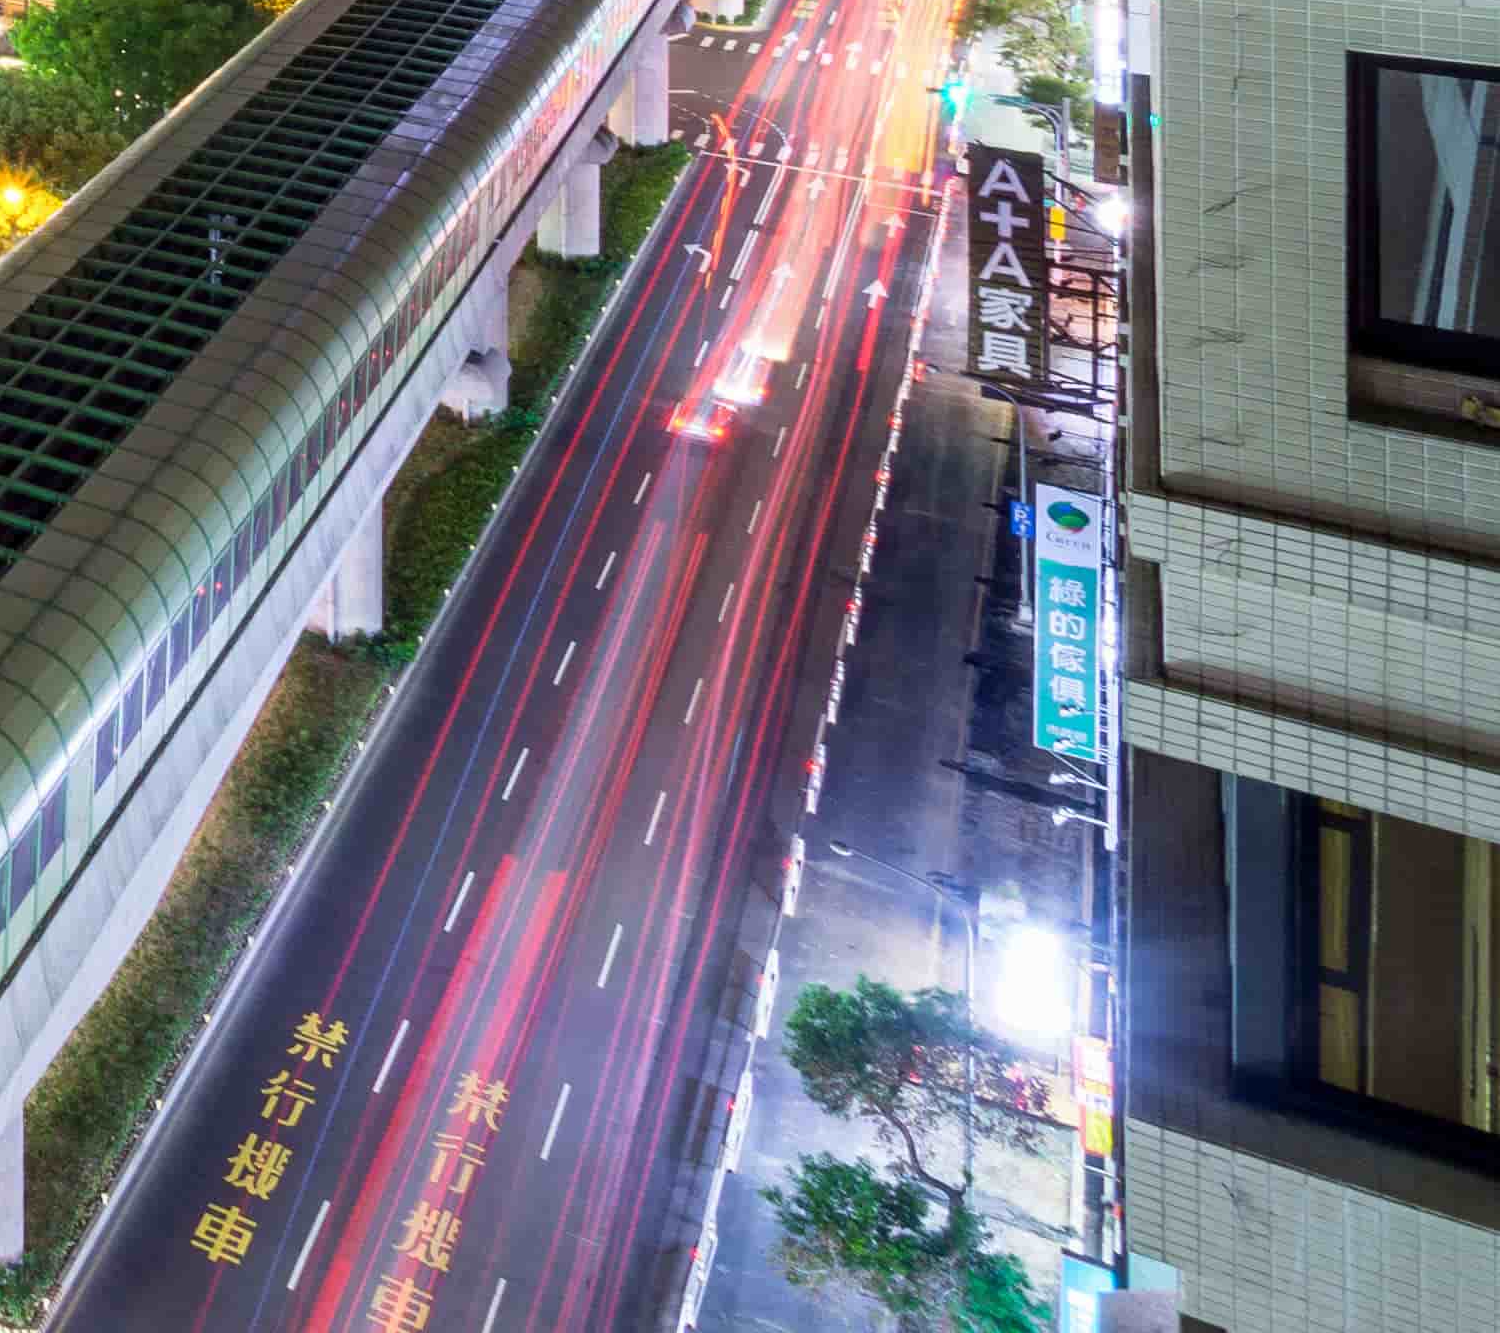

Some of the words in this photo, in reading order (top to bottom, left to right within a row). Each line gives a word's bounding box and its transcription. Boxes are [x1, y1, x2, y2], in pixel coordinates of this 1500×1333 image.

[978, 159, 1032, 379] A+A家具
[190, 1012, 349, 1265] 禁行機車
[366, 1070, 510, 1333] 禁行機車
